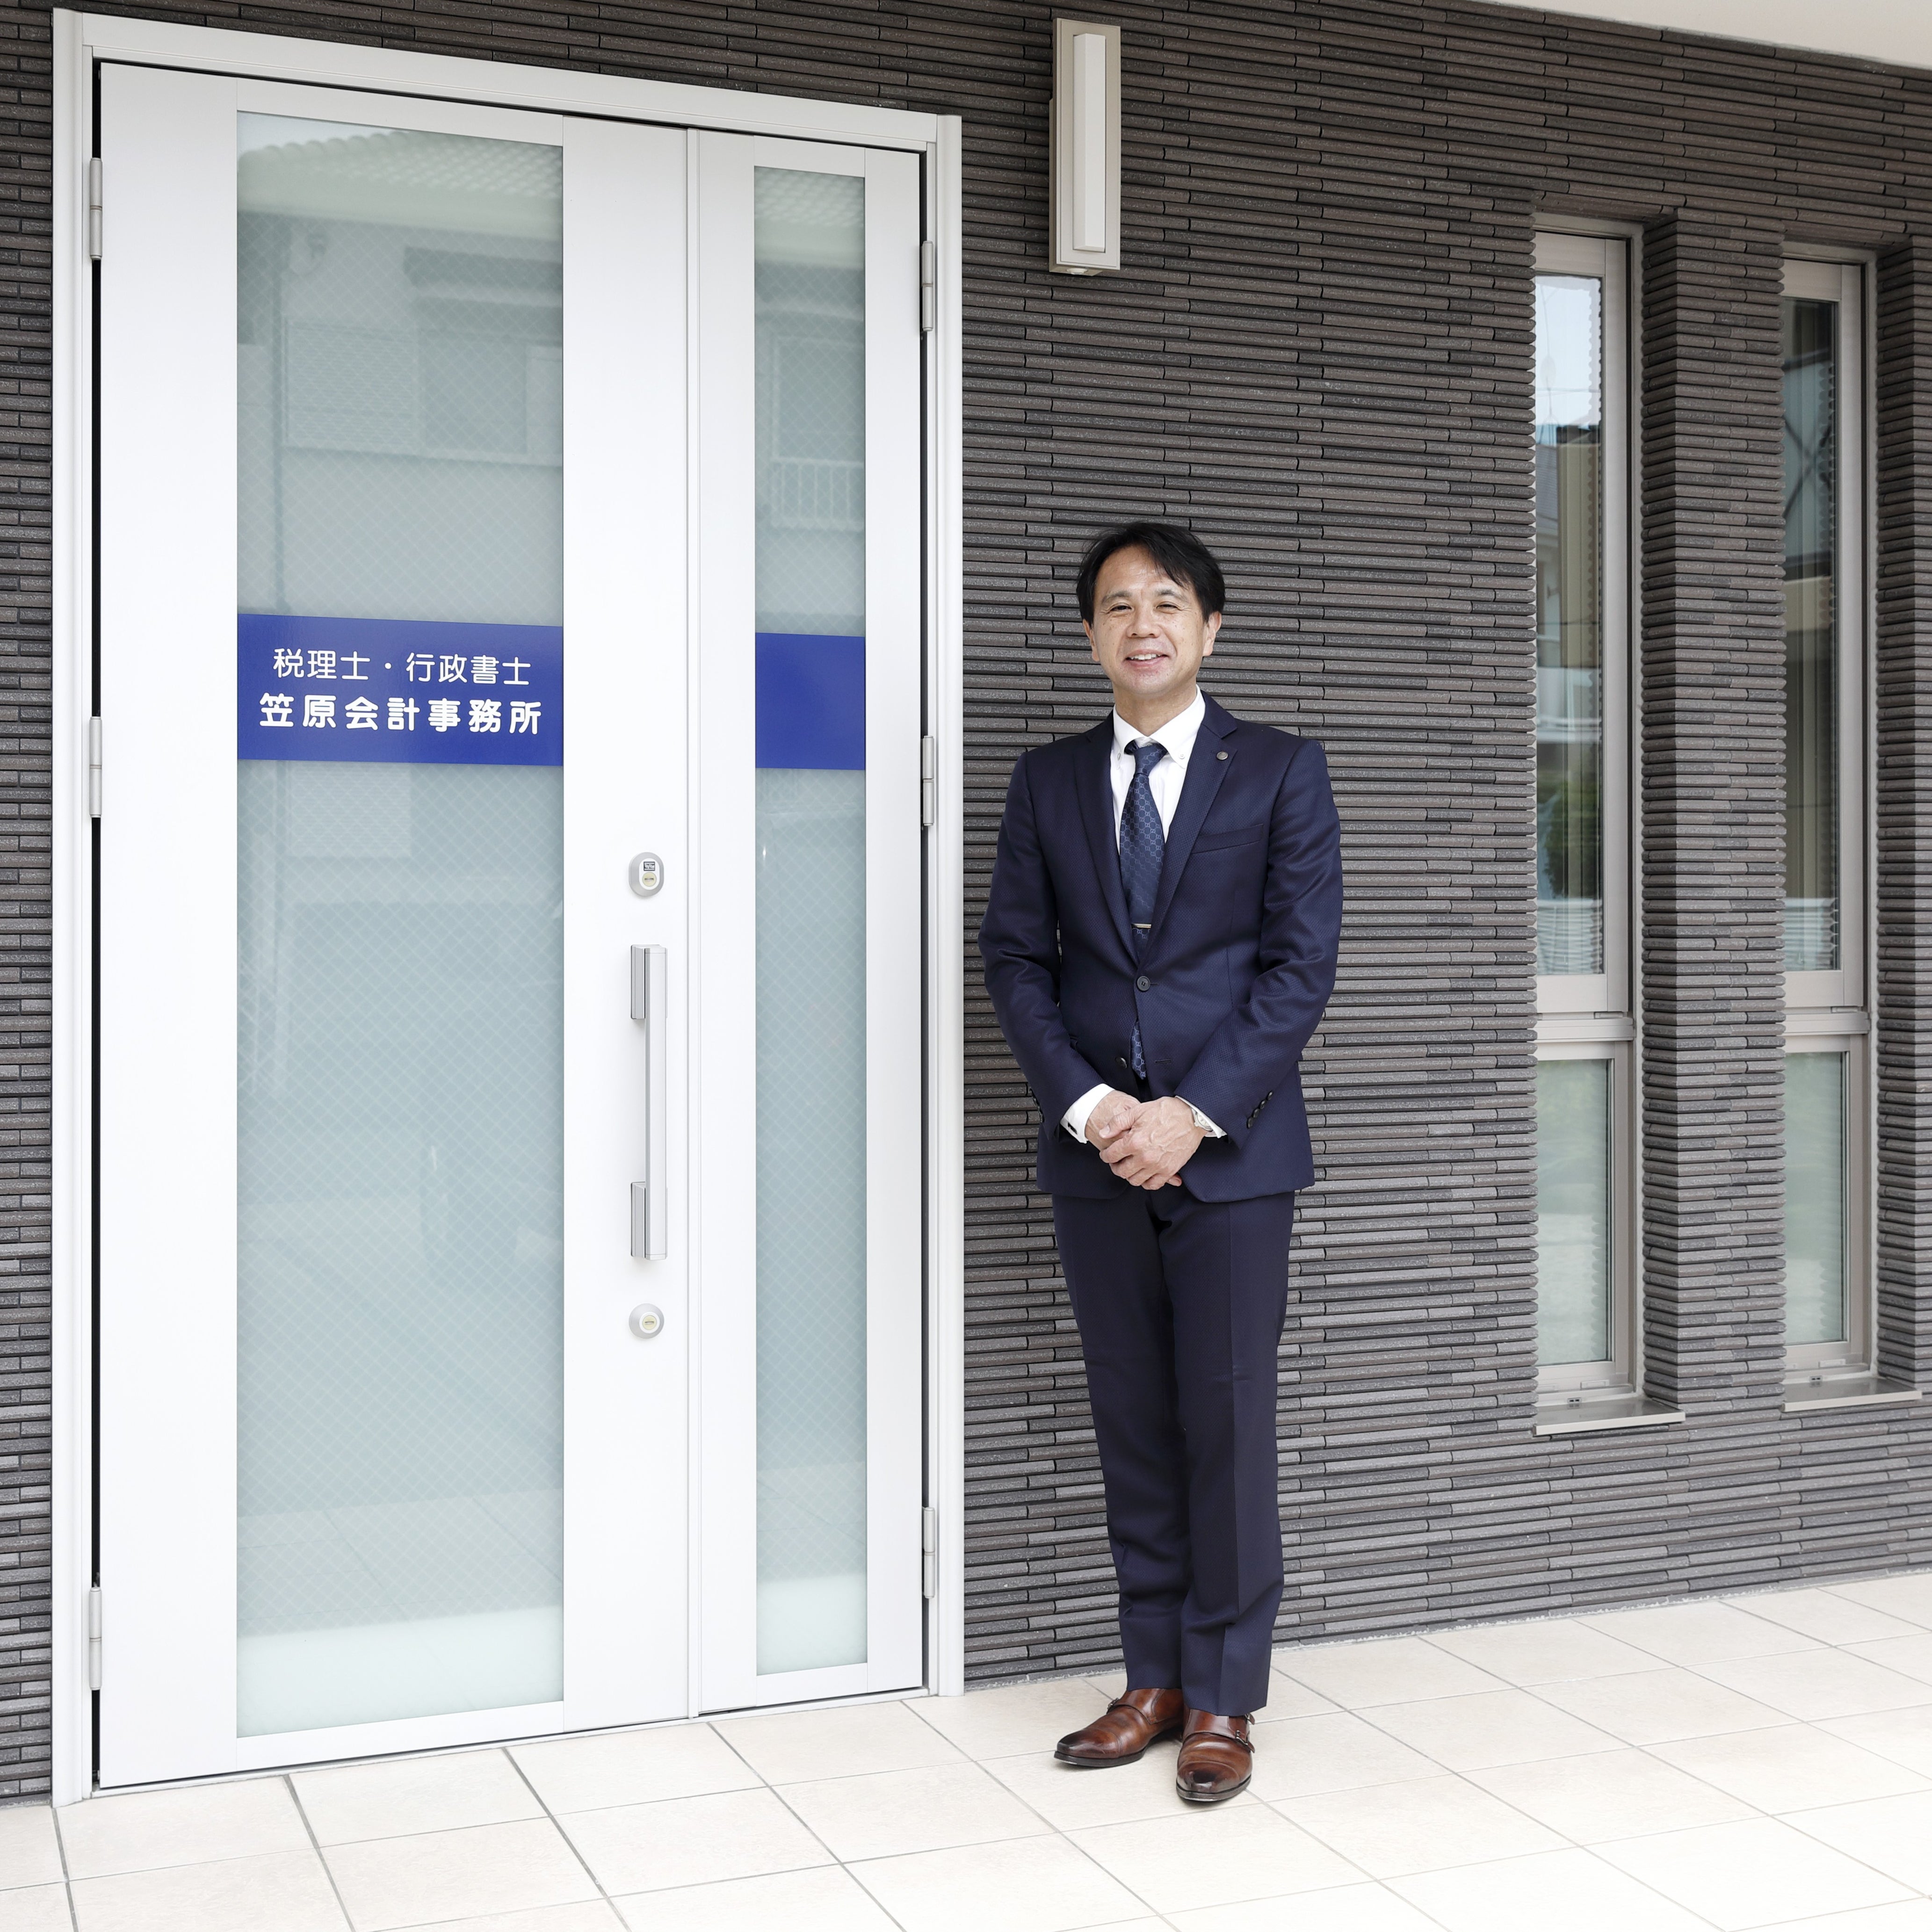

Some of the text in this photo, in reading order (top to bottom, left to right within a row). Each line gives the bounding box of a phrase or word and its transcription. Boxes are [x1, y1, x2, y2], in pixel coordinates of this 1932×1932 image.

[273, 648, 531, 685] 税理士・行政書士
[260, 693, 542, 735] 笠原会計事務所
